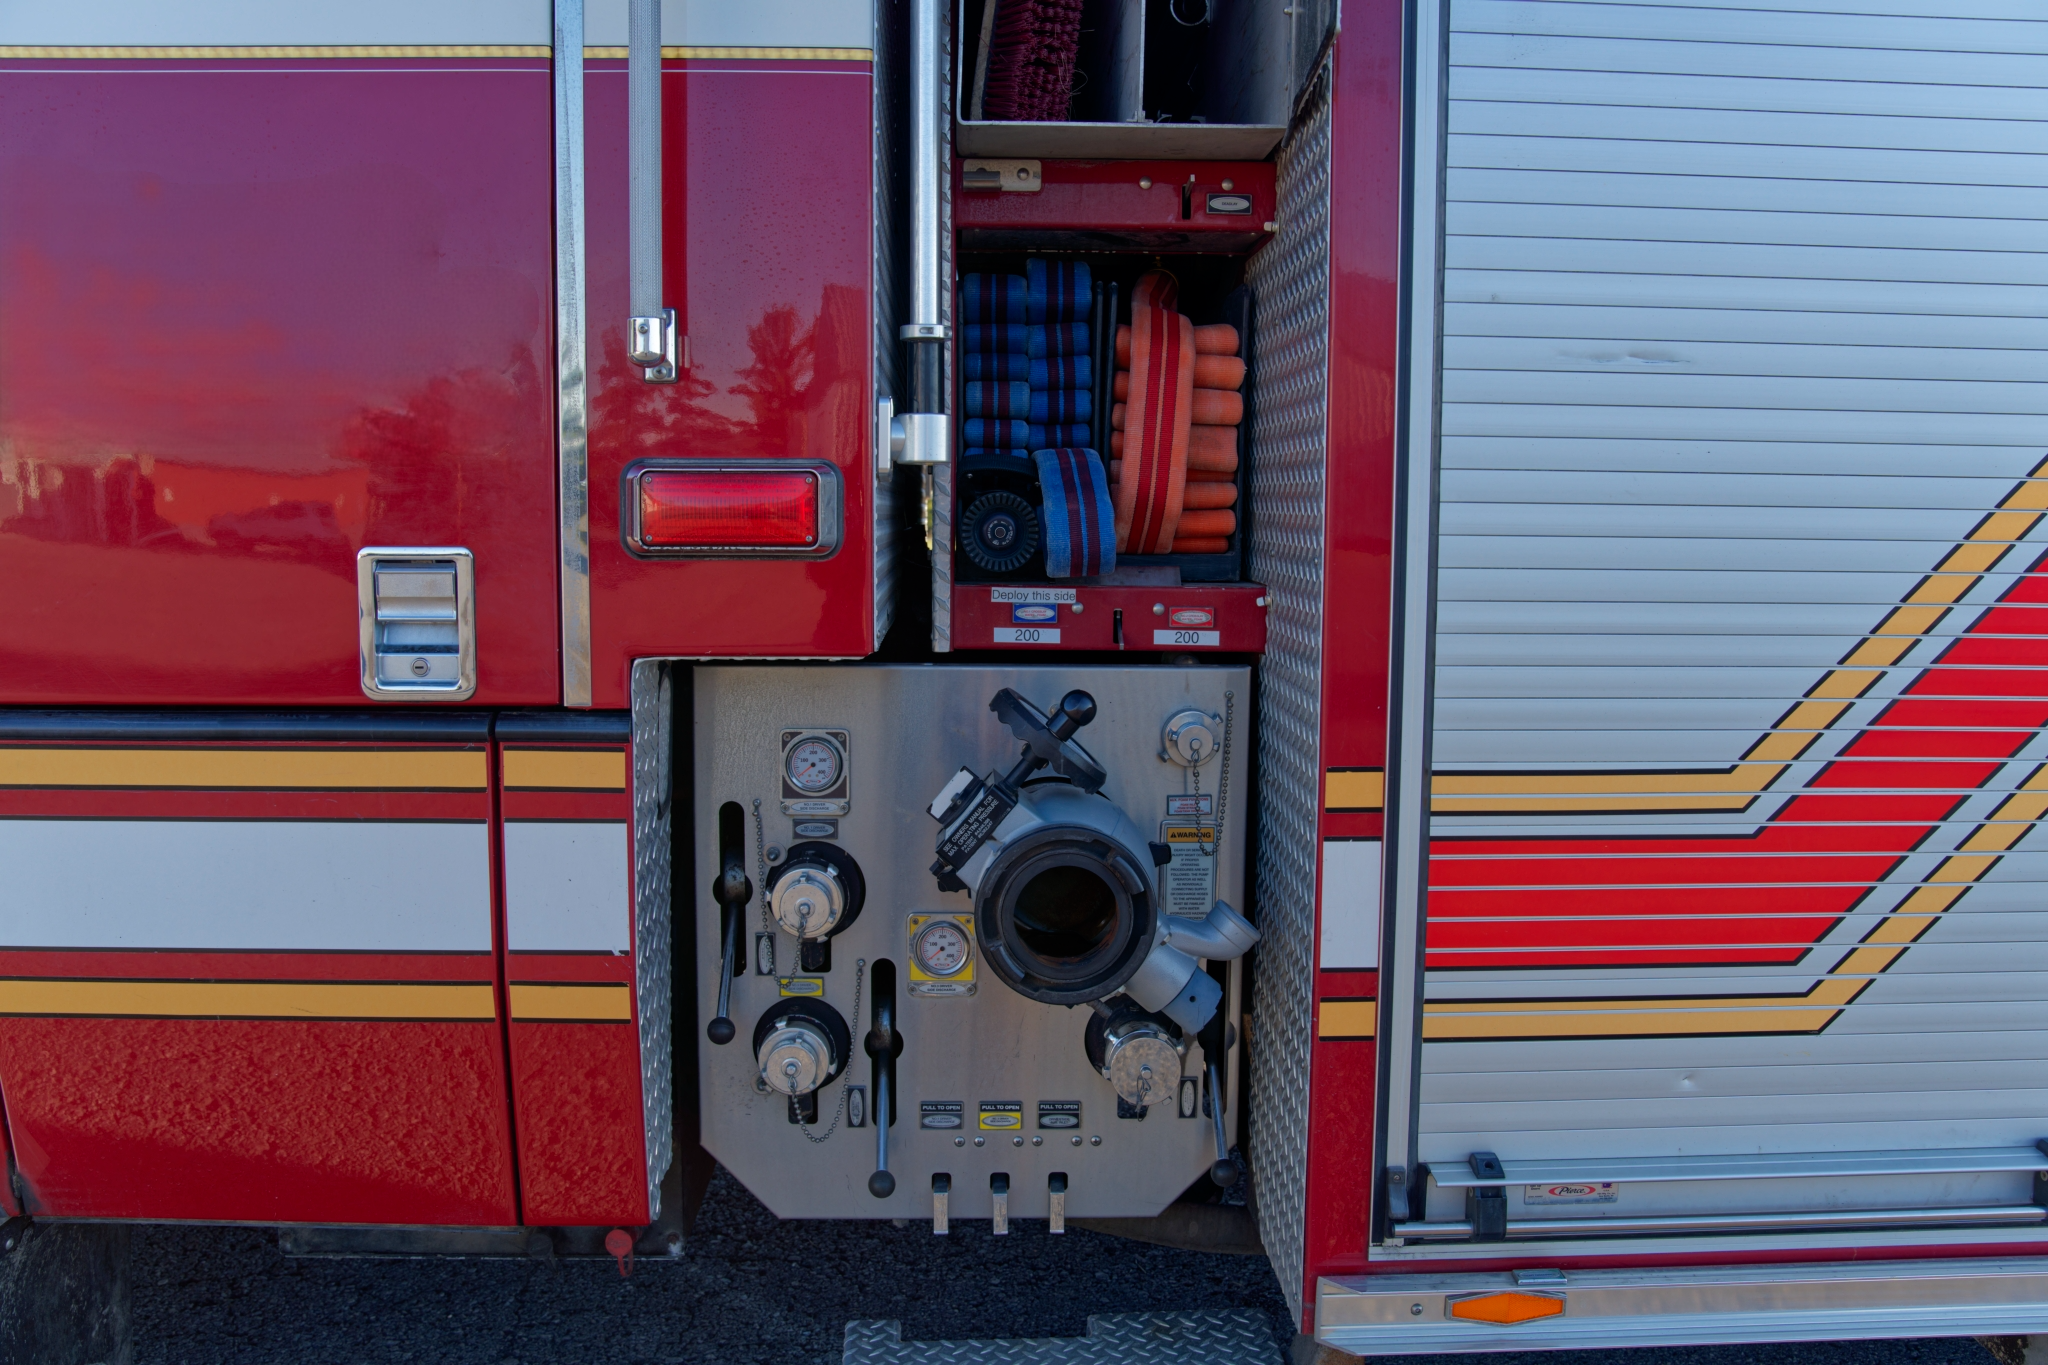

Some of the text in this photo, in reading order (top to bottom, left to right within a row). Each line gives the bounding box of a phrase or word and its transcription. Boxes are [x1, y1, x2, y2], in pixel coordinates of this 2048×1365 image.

[992, 589, 1076, 601] Deploy this side
[1015, 629, 1040, 641] 200
[1175, 631, 1199, 644] 200
[943, 795, 994, 853] SEE OWNERS MANUAL FOR
[948, 799, 999, 857] MAX OPERATING PRESSURE
[961, 836, 974, 850] PATENT
[965, 839, 977, 853] PATENT
[1559, 1186, 1584, 1195] Pierce
